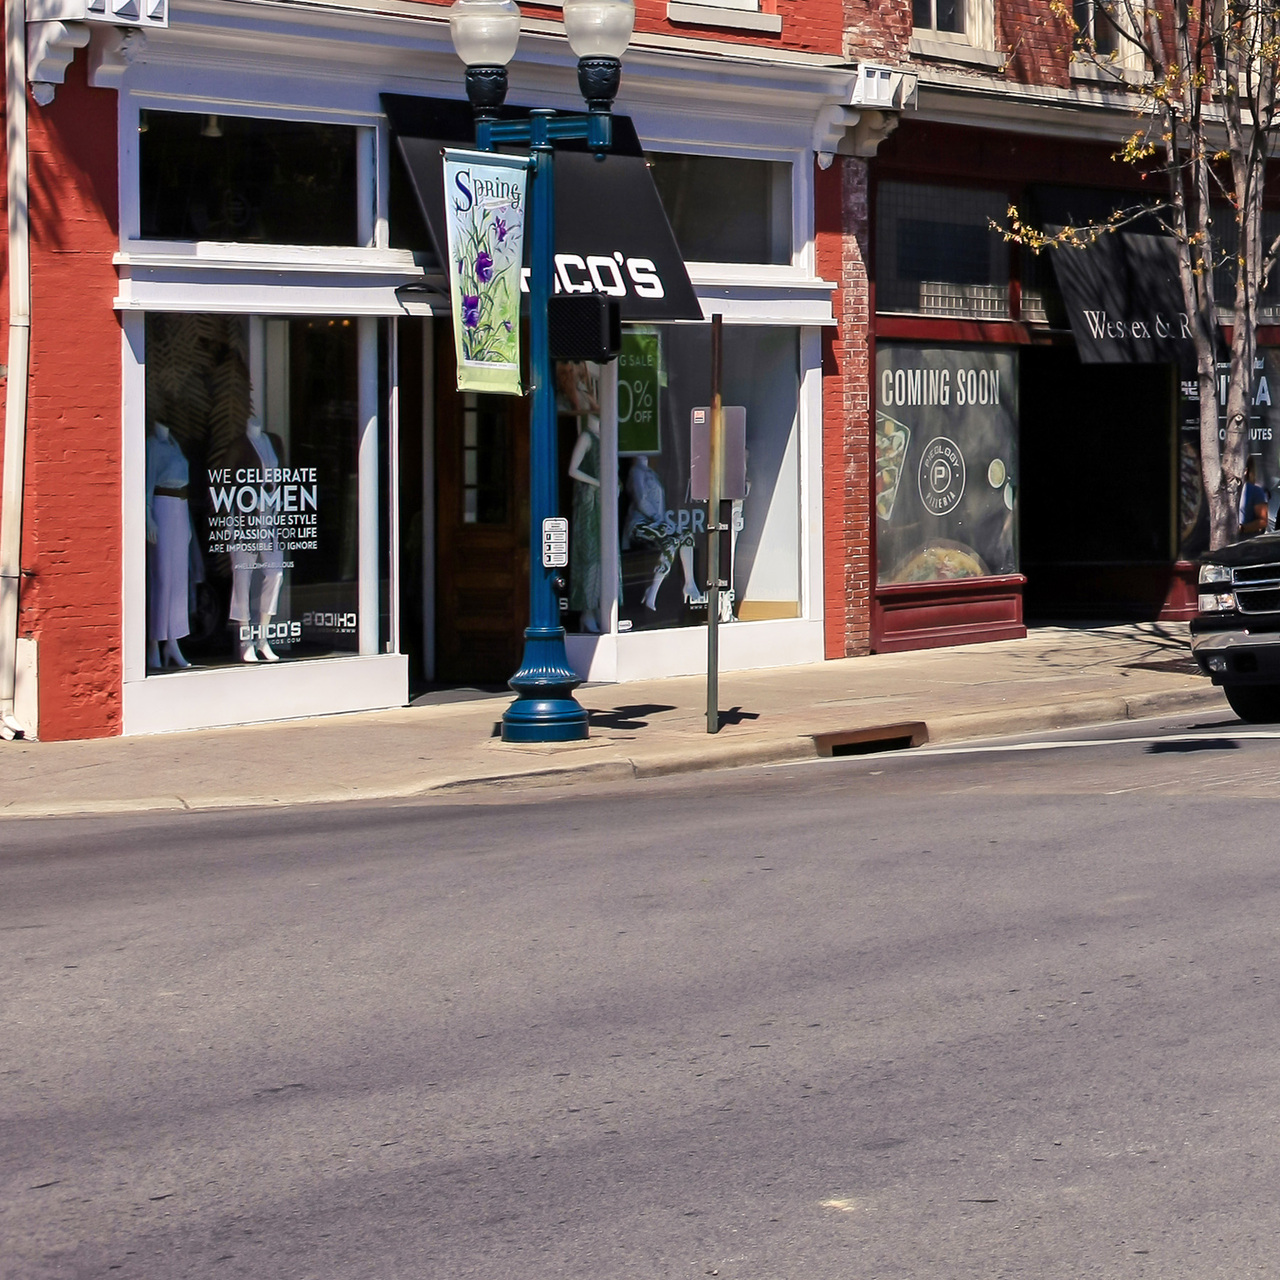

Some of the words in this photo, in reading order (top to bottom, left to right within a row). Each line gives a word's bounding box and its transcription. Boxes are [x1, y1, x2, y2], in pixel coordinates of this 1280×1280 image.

[454, 168, 522, 212] Spring
[1083, 310, 1151, 339] Wessex
[629, 354, 654, 367] SALE
[881, 368, 950, 407] COMING
[956, 368, 1000, 406] SOON
[634, 410, 653, 423] OFF
[924, 445, 960, 468] PIEOLOGY
[208, 468, 232, 484] WE
[235, 467, 317, 484] CELEBRATE
[208, 485, 318, 513] WOMEN
[208, 515, 246, 527] WHOSE
[247, 514, 286, 526] UNIQUE
[288, 514, 317, 525] STYLE
[208, 529, 231, 541] AND
[233, 528, 275, 541] PASSION
[277, 527, 296, 539] FOR
[297, 527, 317, 538] LIFE
[208, 543, 225, 553] ARE
[226, 542, 273, 553] IMPOSSIBLE
[274, 541, 286, 551] TO
[287, 540, 318, 550] IGNORE
[239, 619, 302, 641] CHICO'S
